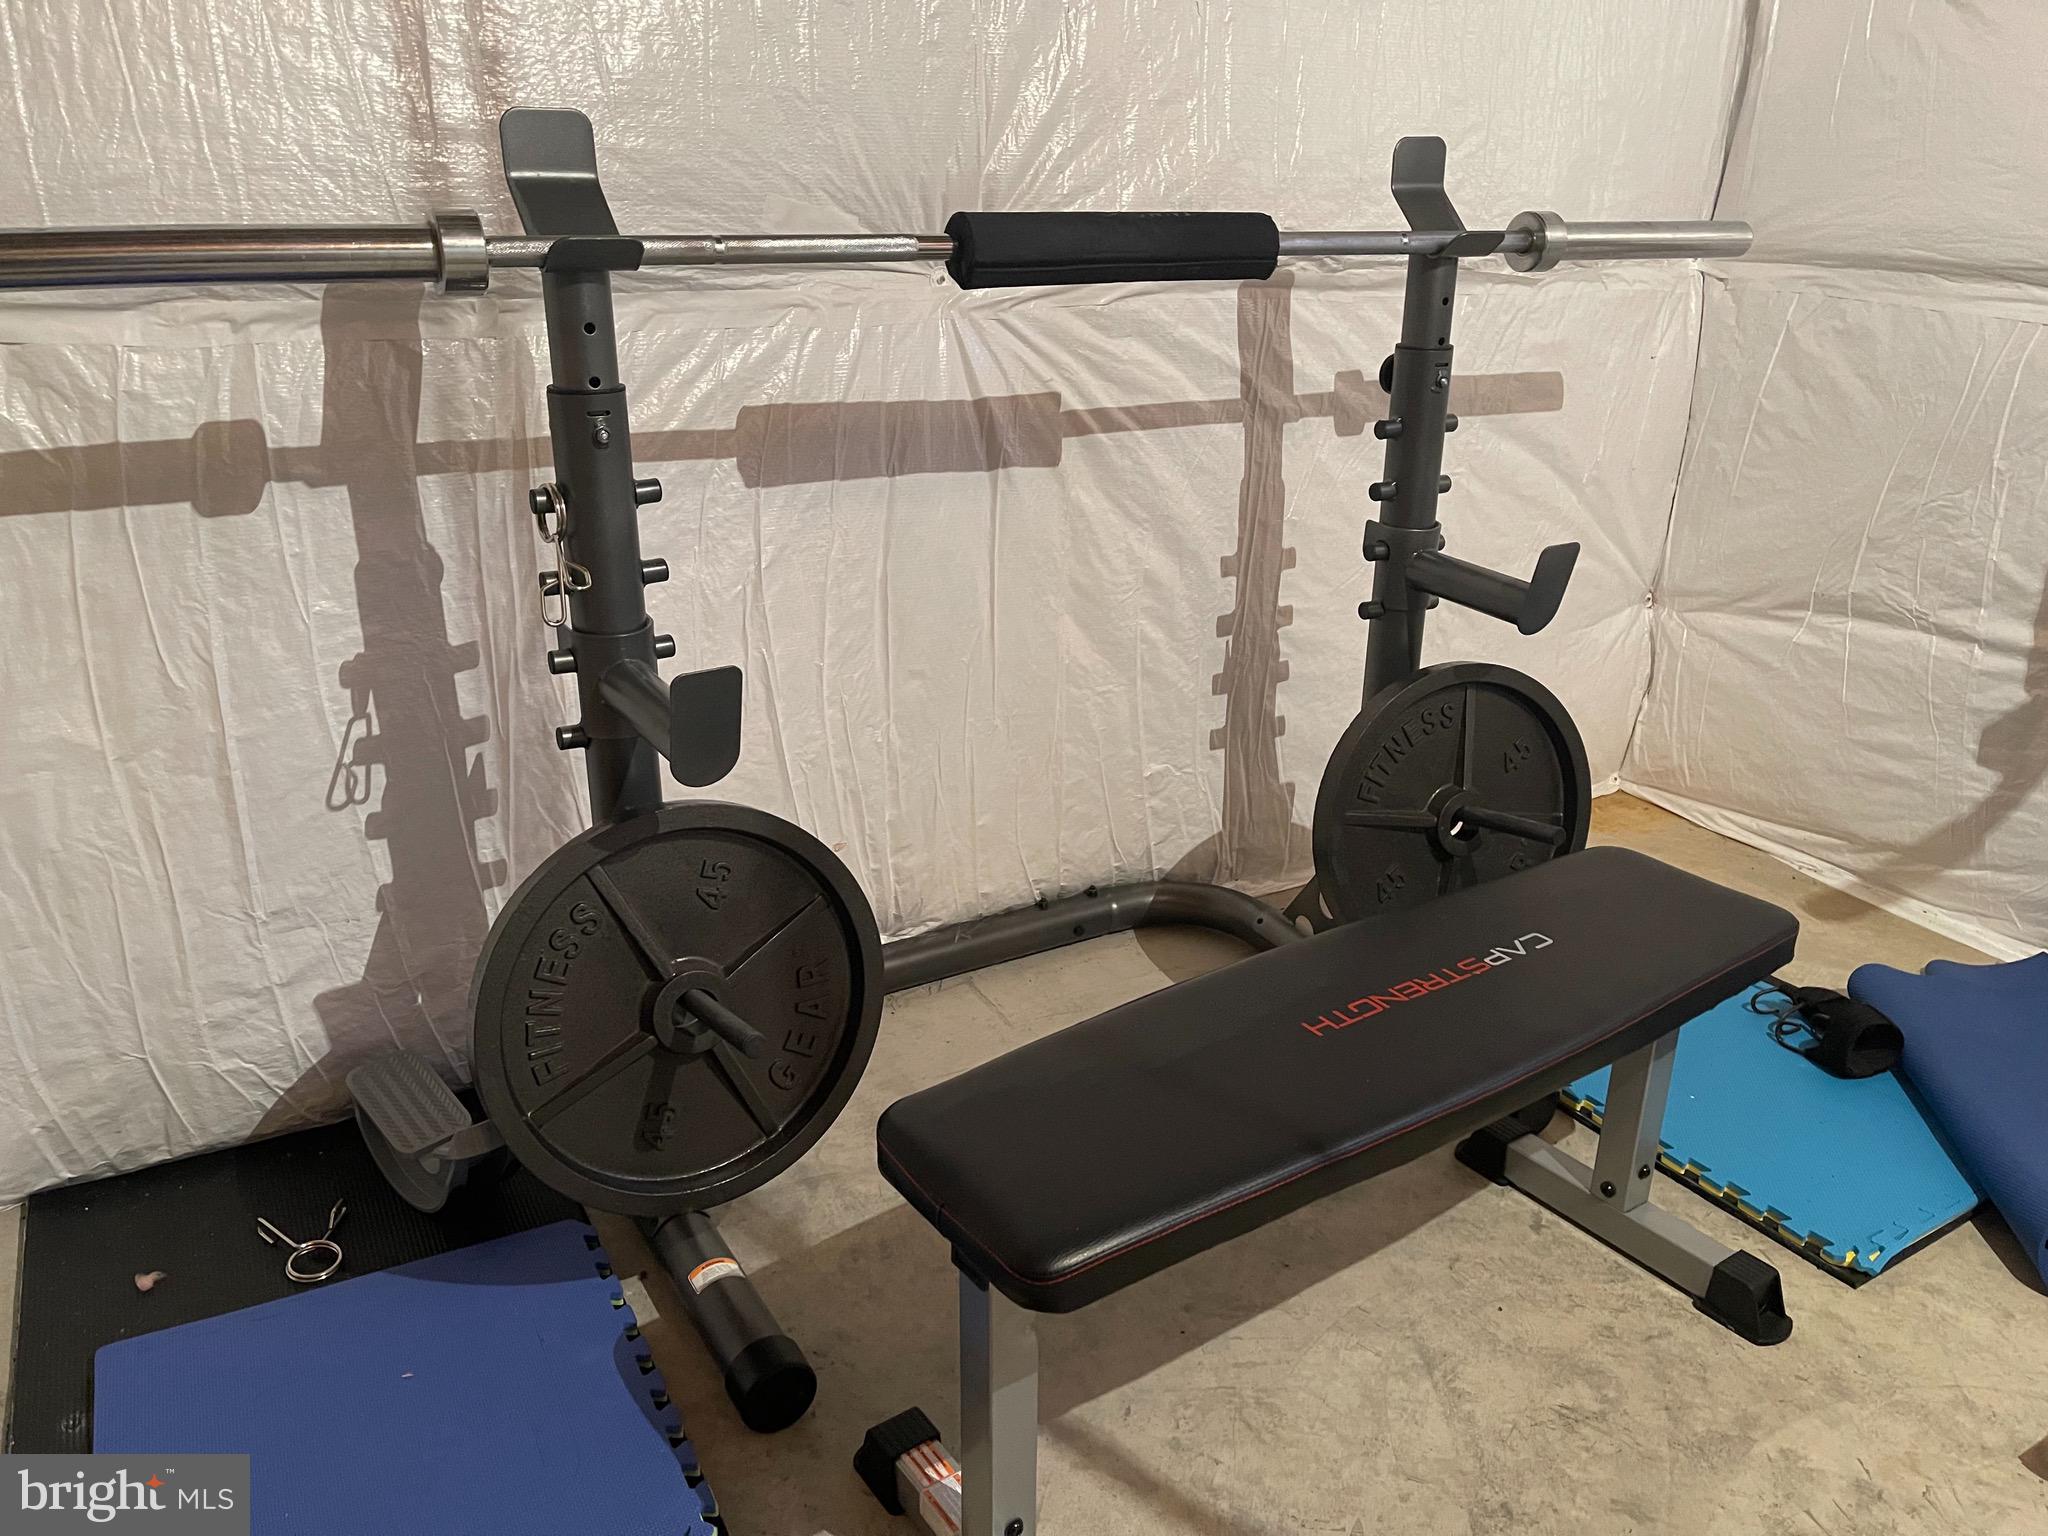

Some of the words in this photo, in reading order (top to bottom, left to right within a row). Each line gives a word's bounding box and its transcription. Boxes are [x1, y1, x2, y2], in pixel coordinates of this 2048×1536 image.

[1357, 702, 1455, 804] FITNESS
[1503, 738, 1530, 774] 45
[696, 859, 731, 910] 45
[1376, 864, 1406, 904] 45
[525, 902, 601, 1086] FITNESS
[768, 957, 828, 1091] GEAR
[641, 1102, 675, 1151] 45
